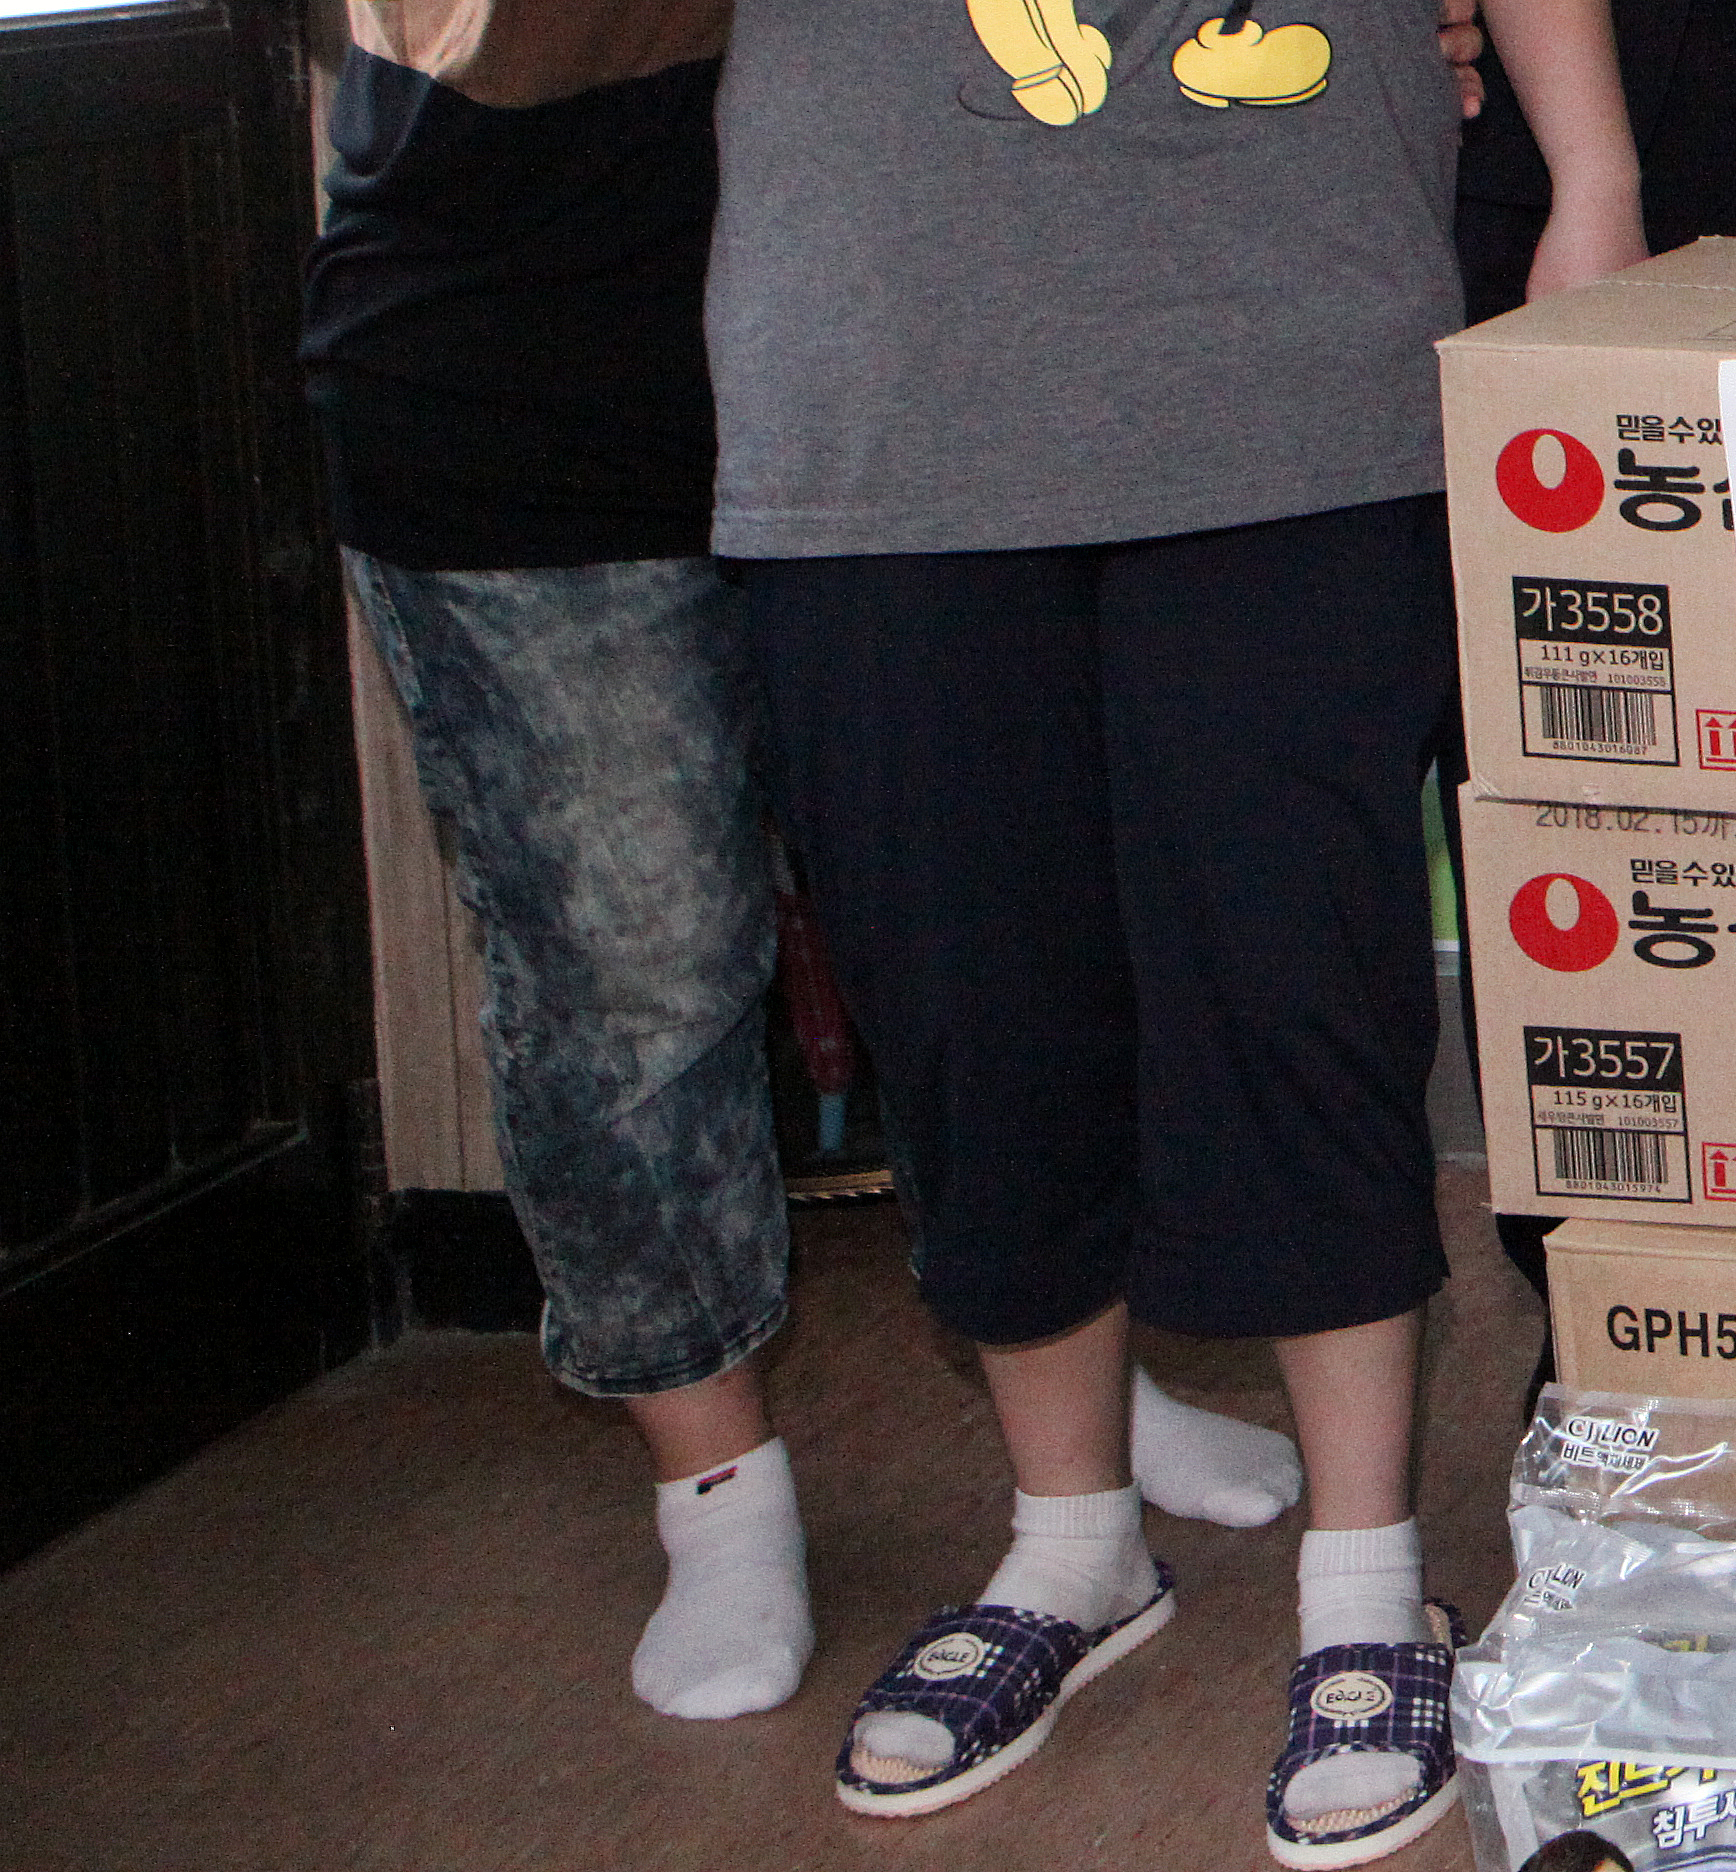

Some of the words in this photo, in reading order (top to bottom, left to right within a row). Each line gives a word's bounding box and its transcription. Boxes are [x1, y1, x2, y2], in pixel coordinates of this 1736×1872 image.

[1521, 586, 1664, 636] 가3558
[1541, 645, 1573, 662] 111
[1534, 1036, 1675, 1079] 가3557
[1554, 1091, 1587, 1107] 115
[1568, 1417, 1595, 1442] CJ
[1600, 1425, 1656, 1447] LION
